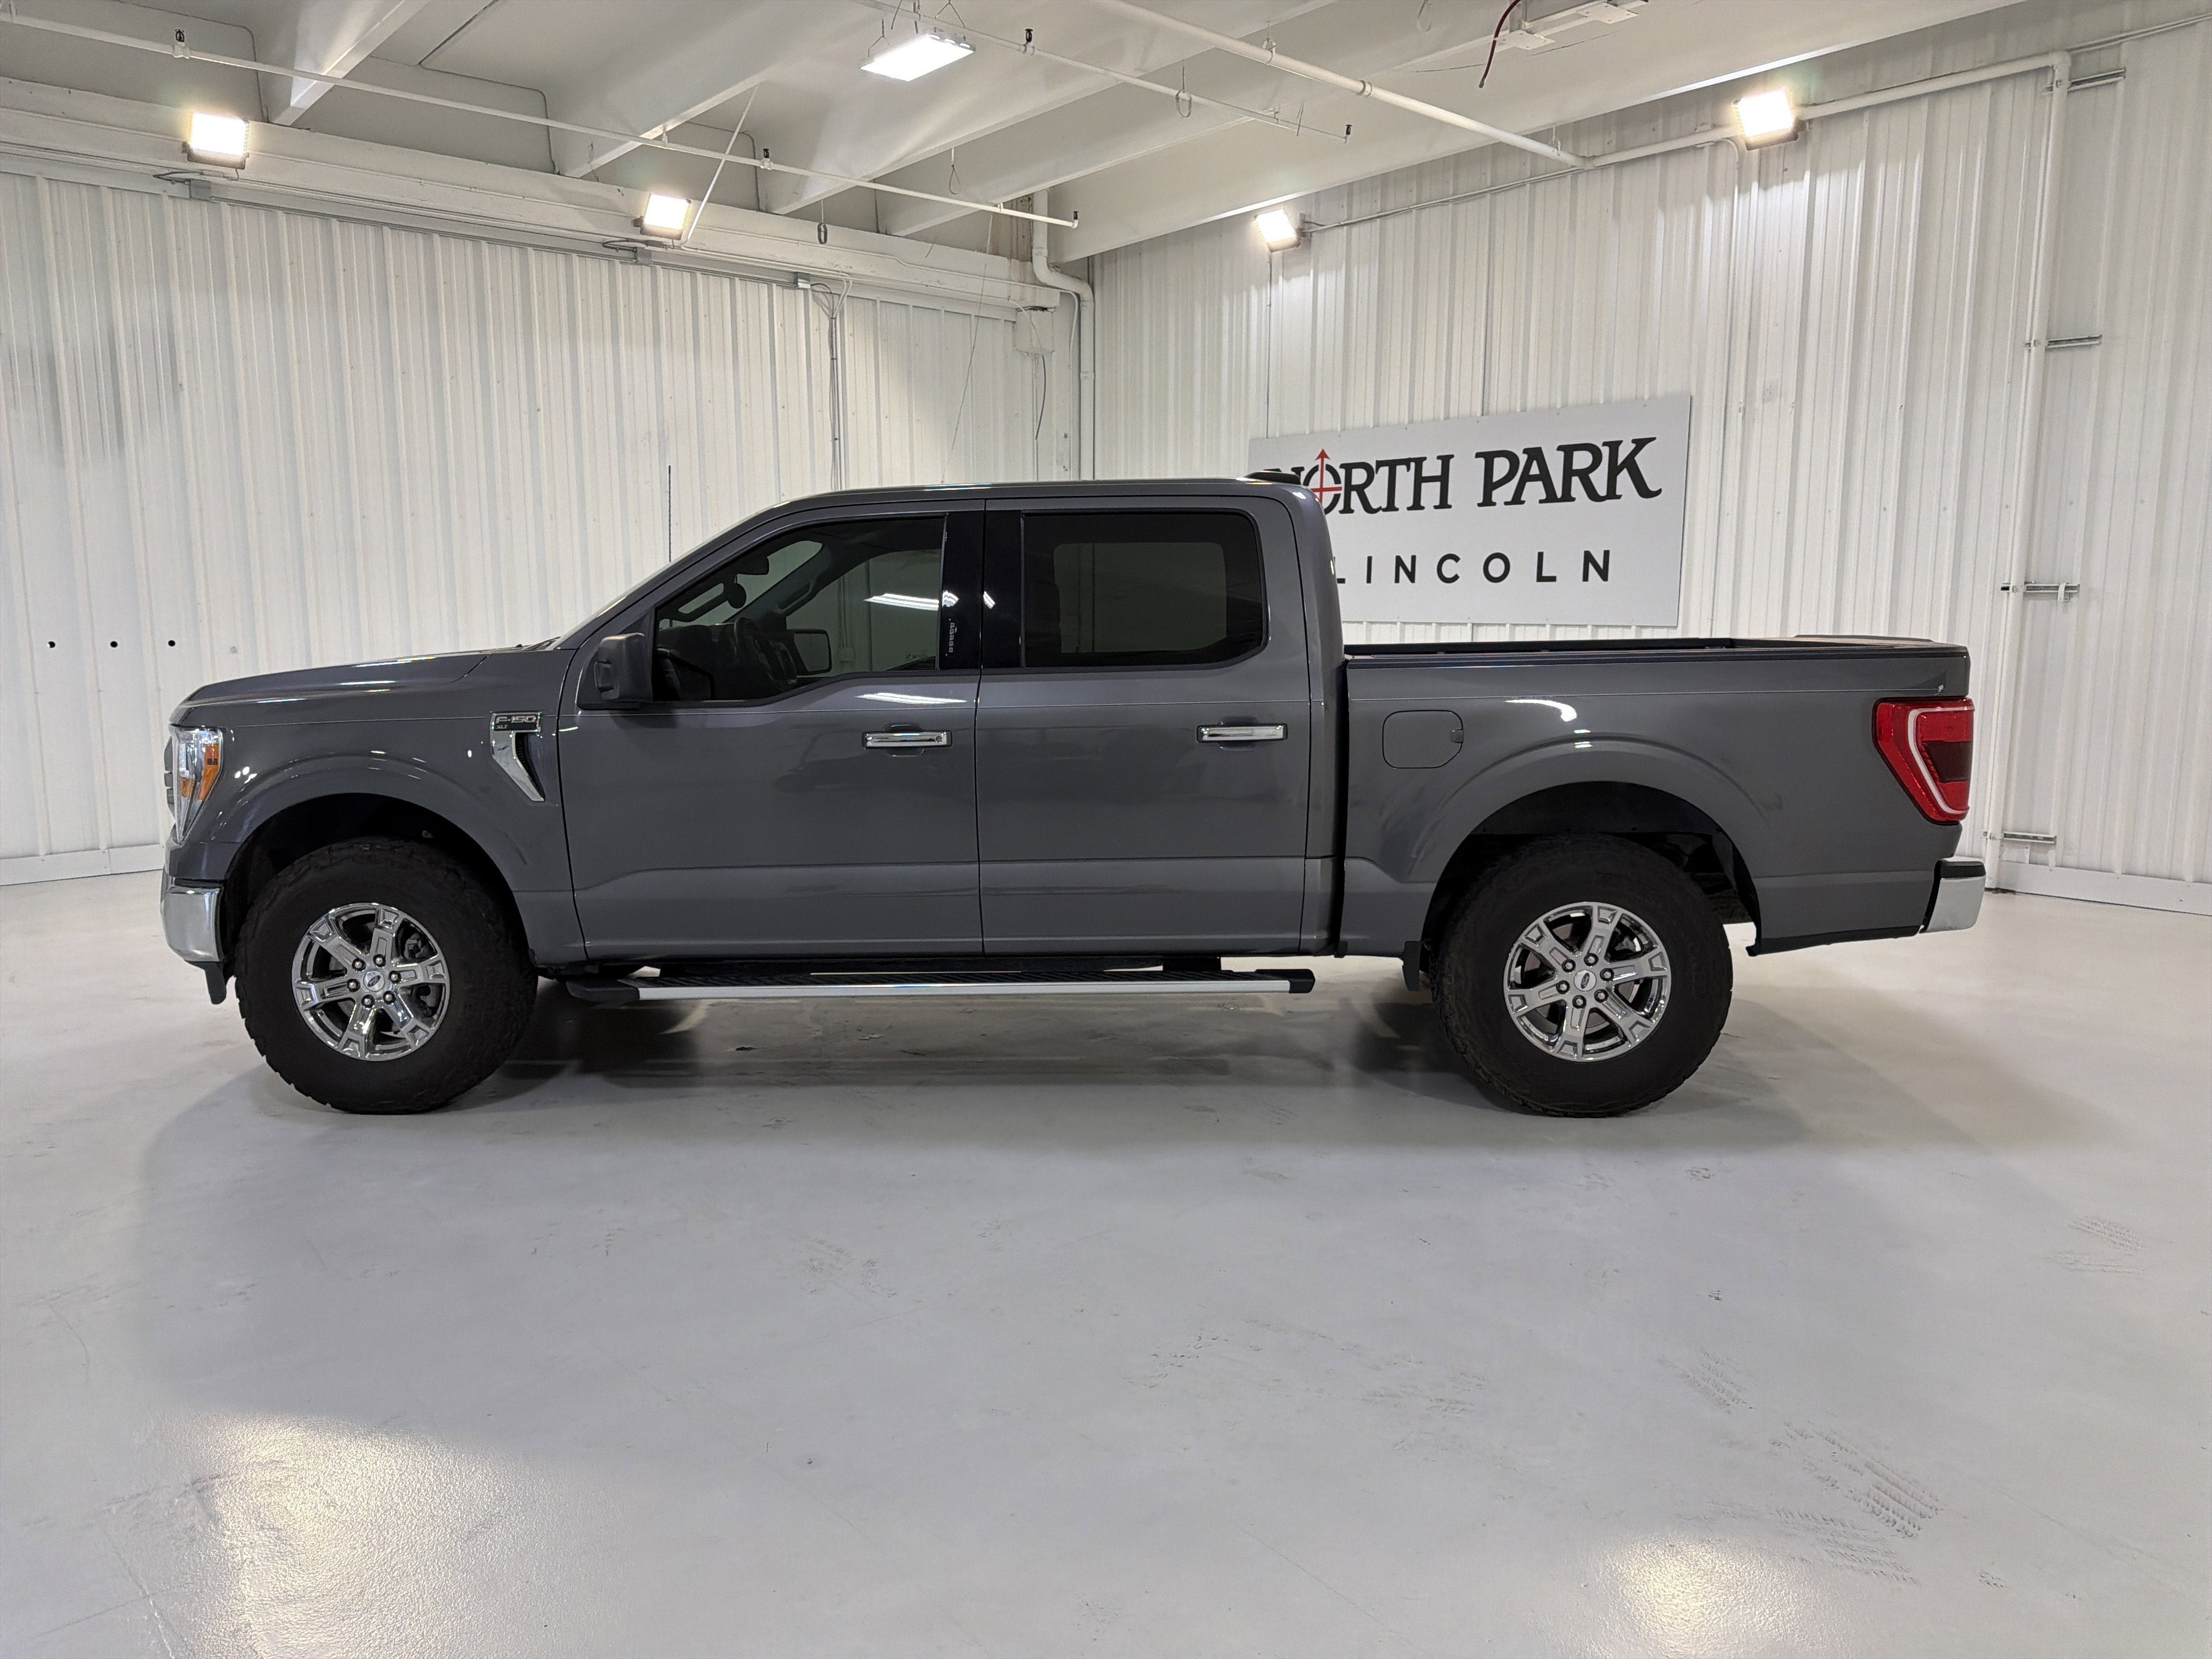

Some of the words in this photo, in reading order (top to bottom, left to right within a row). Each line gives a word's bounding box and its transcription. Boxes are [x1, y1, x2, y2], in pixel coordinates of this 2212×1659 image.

[1263, 455, 1454, 515] ORTH
[1475, 437, 1662, 507] PARK
[495, 715, 537, 724] F-150
